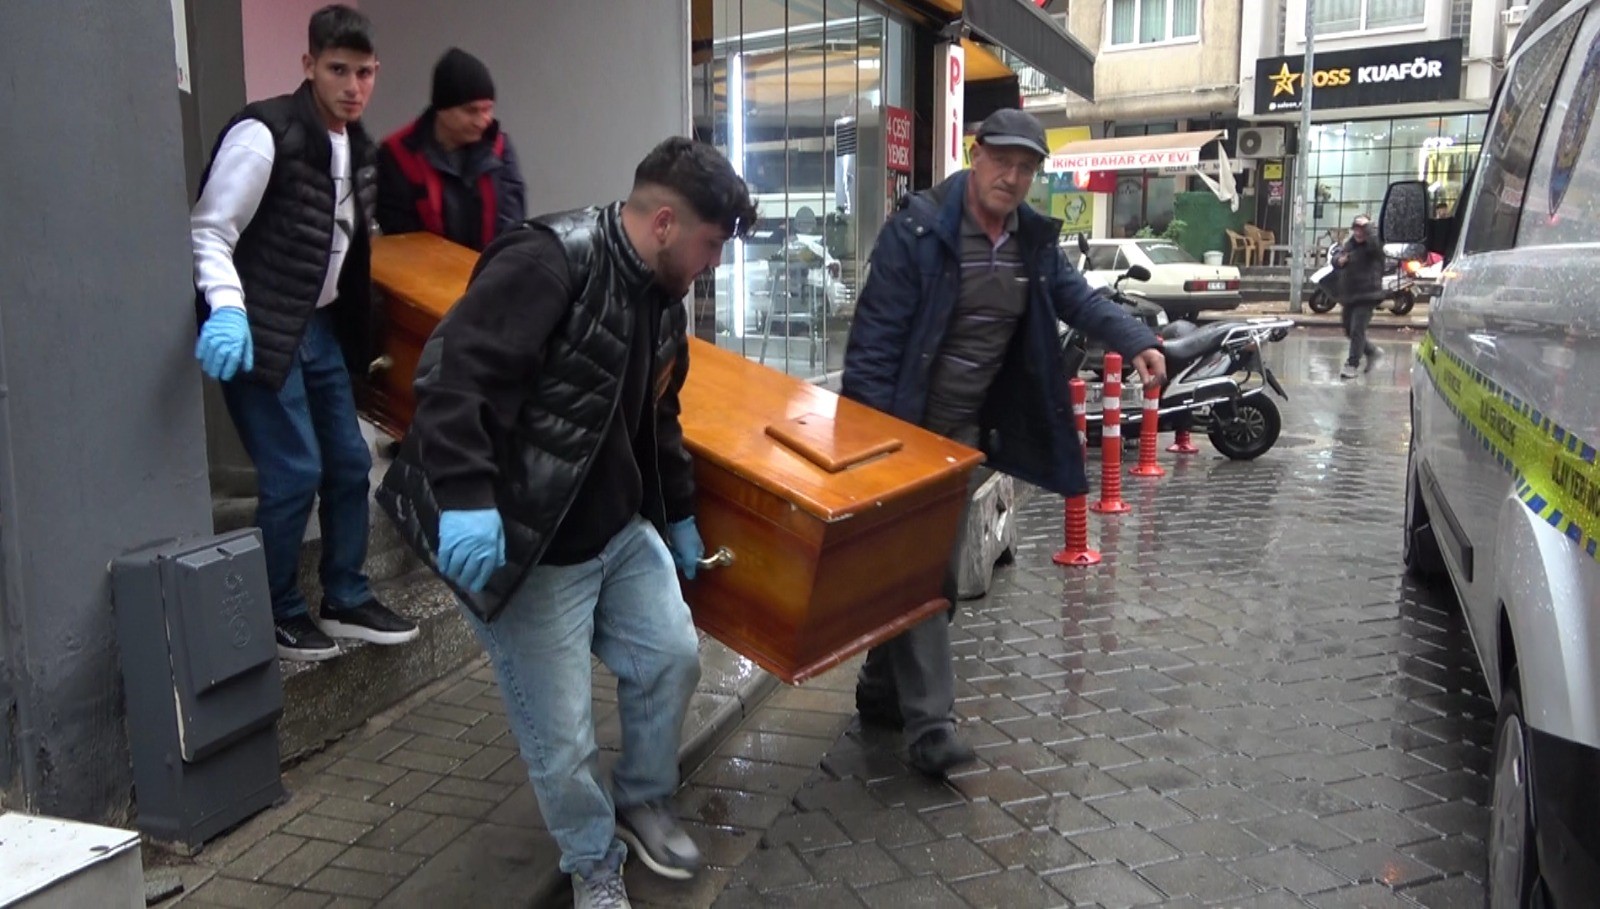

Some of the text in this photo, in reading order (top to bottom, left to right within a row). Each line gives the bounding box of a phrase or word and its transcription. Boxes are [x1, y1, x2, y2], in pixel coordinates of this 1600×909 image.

[1357, 57, 1442, 84] KUAFÖR
[893, 115, 911, 143] ÇEŞİT
[888, 144, 909, 166] YEMEK
[1052, 152, 1190, 169] İKİNCİ BAHAR ÇAY EVİ
